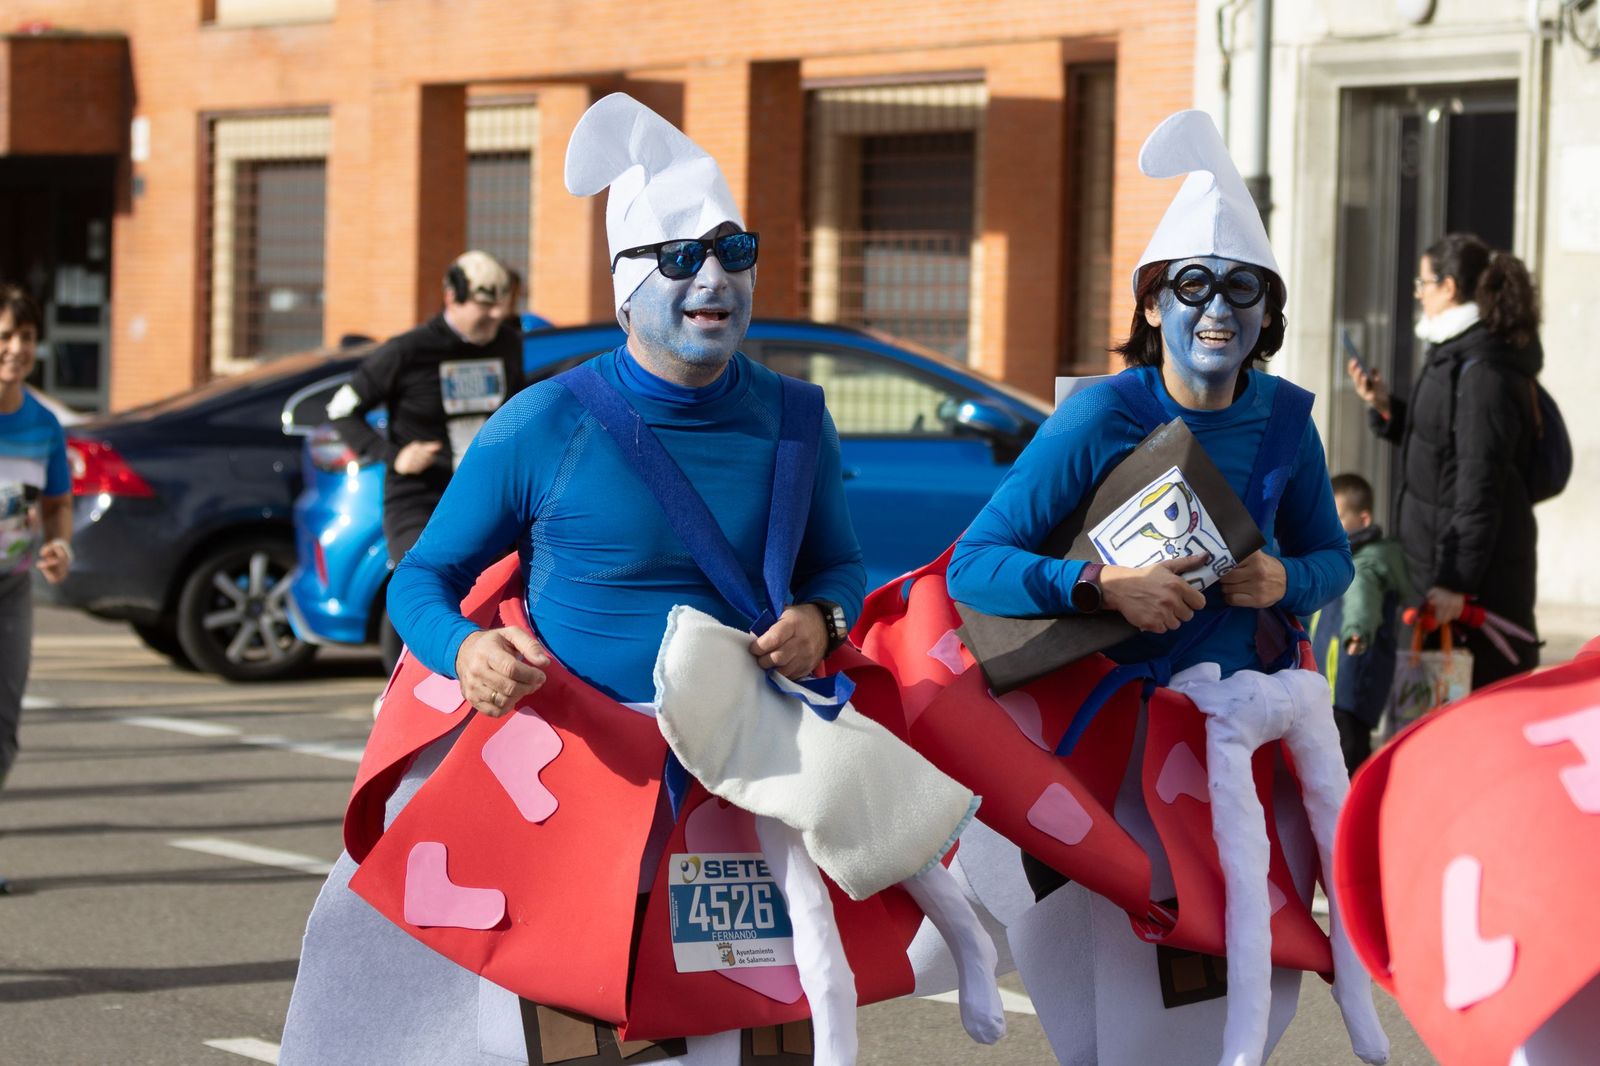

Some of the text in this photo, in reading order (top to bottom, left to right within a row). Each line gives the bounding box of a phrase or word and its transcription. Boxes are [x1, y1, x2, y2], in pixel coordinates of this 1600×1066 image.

[688, 884, 775, 932] 4526
[712, 930, 757, 941] FERNANDO
[736, 947, 774, 956] Ayuntamiento
[747, 956, 776, 964] Salamanca
